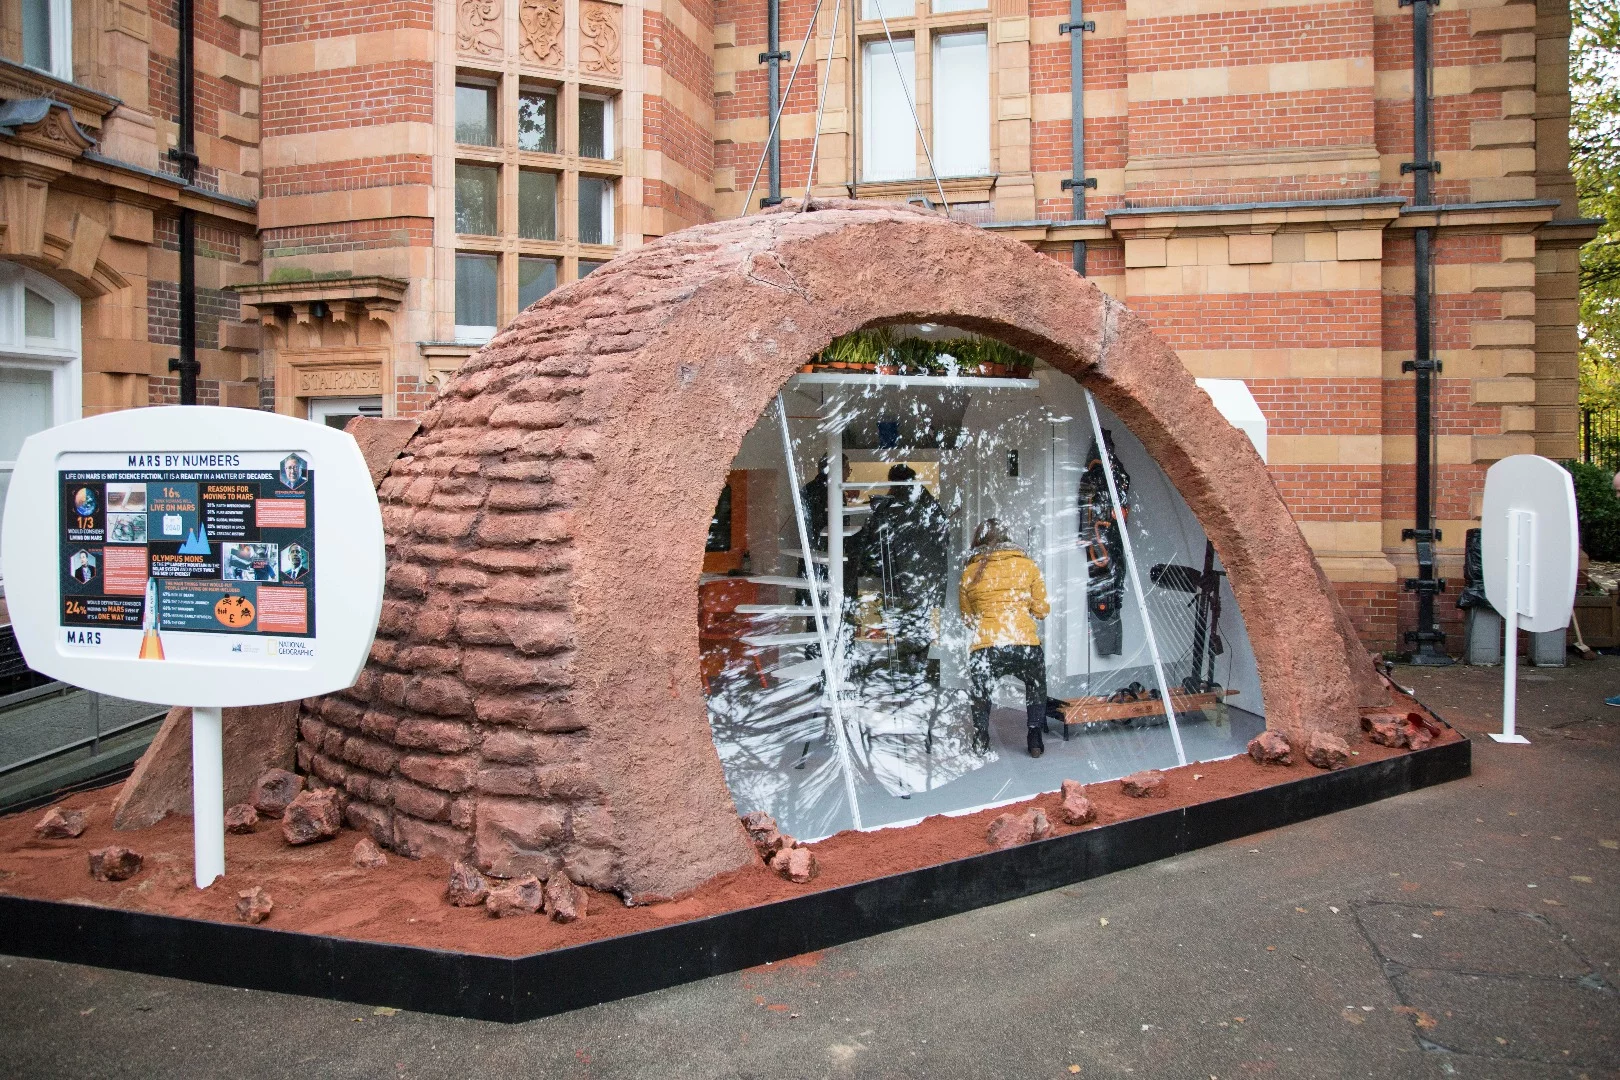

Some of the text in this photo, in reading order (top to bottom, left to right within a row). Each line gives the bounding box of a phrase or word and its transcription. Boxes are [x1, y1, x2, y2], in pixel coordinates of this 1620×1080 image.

[302, 372, 380, 390] STAIRCASE
[128, 455, 240, 467] MARS BY NUMBERS
[163, 488, 180, 498] 16%
[176, 504, 196, 512] MARS
[77, 517, 94, 529] 1/3
[66, 601, 87, 614] 24%
[67, 631, 101, 645] MARS
[278, 640, 306, 649] NATIONAL
[278, 647, 314, 657] GEOGRAPHIC
